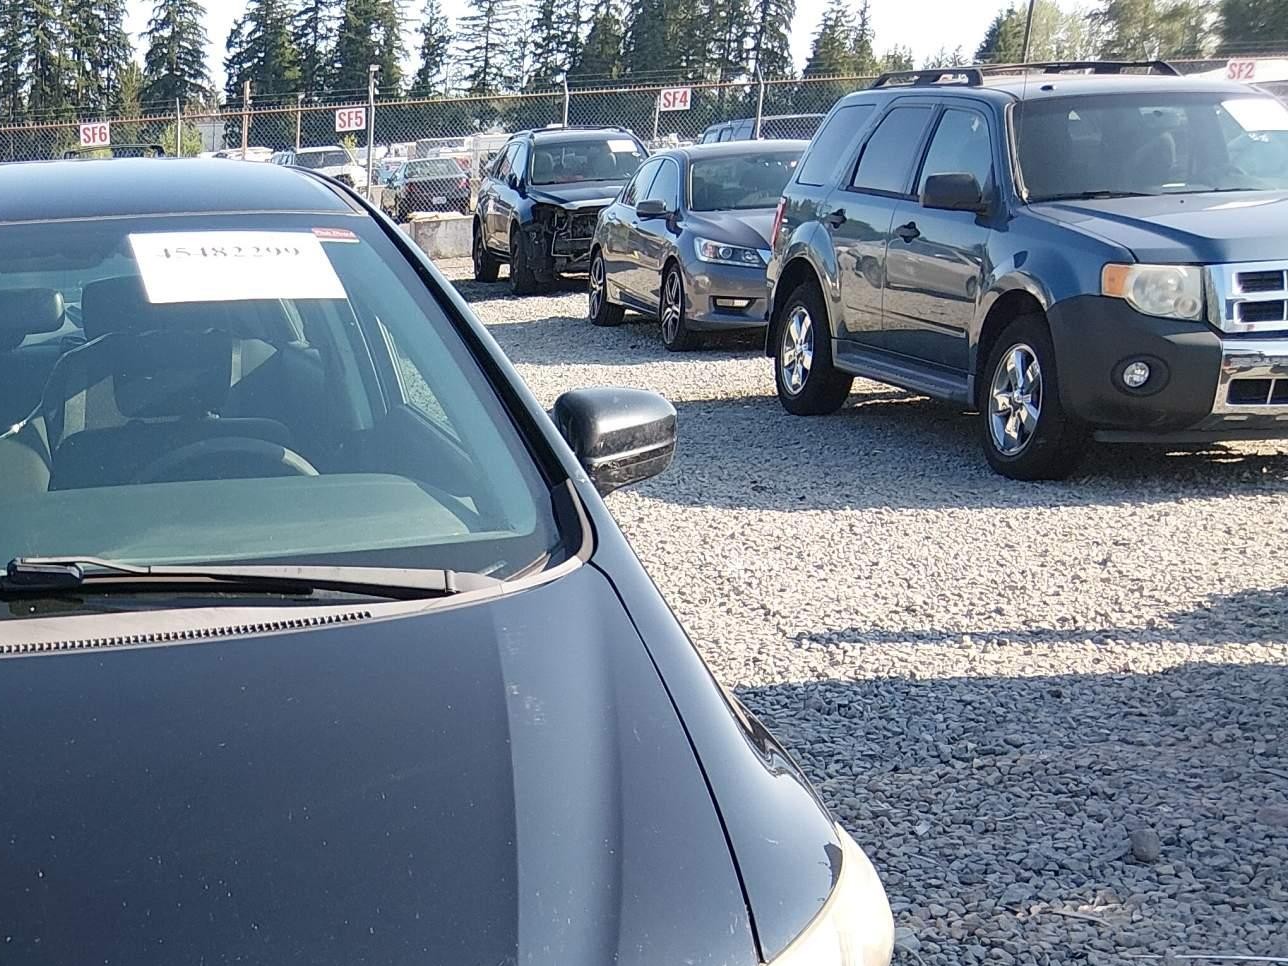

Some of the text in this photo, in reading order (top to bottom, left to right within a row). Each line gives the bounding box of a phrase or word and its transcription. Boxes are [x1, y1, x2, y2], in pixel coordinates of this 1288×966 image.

[1227, 62, 1255, 80] SF2
[663, 90, 688, 109] SF4
[338, 110, 364, 129] SF5
[82, 125, 108, 144] SF6
